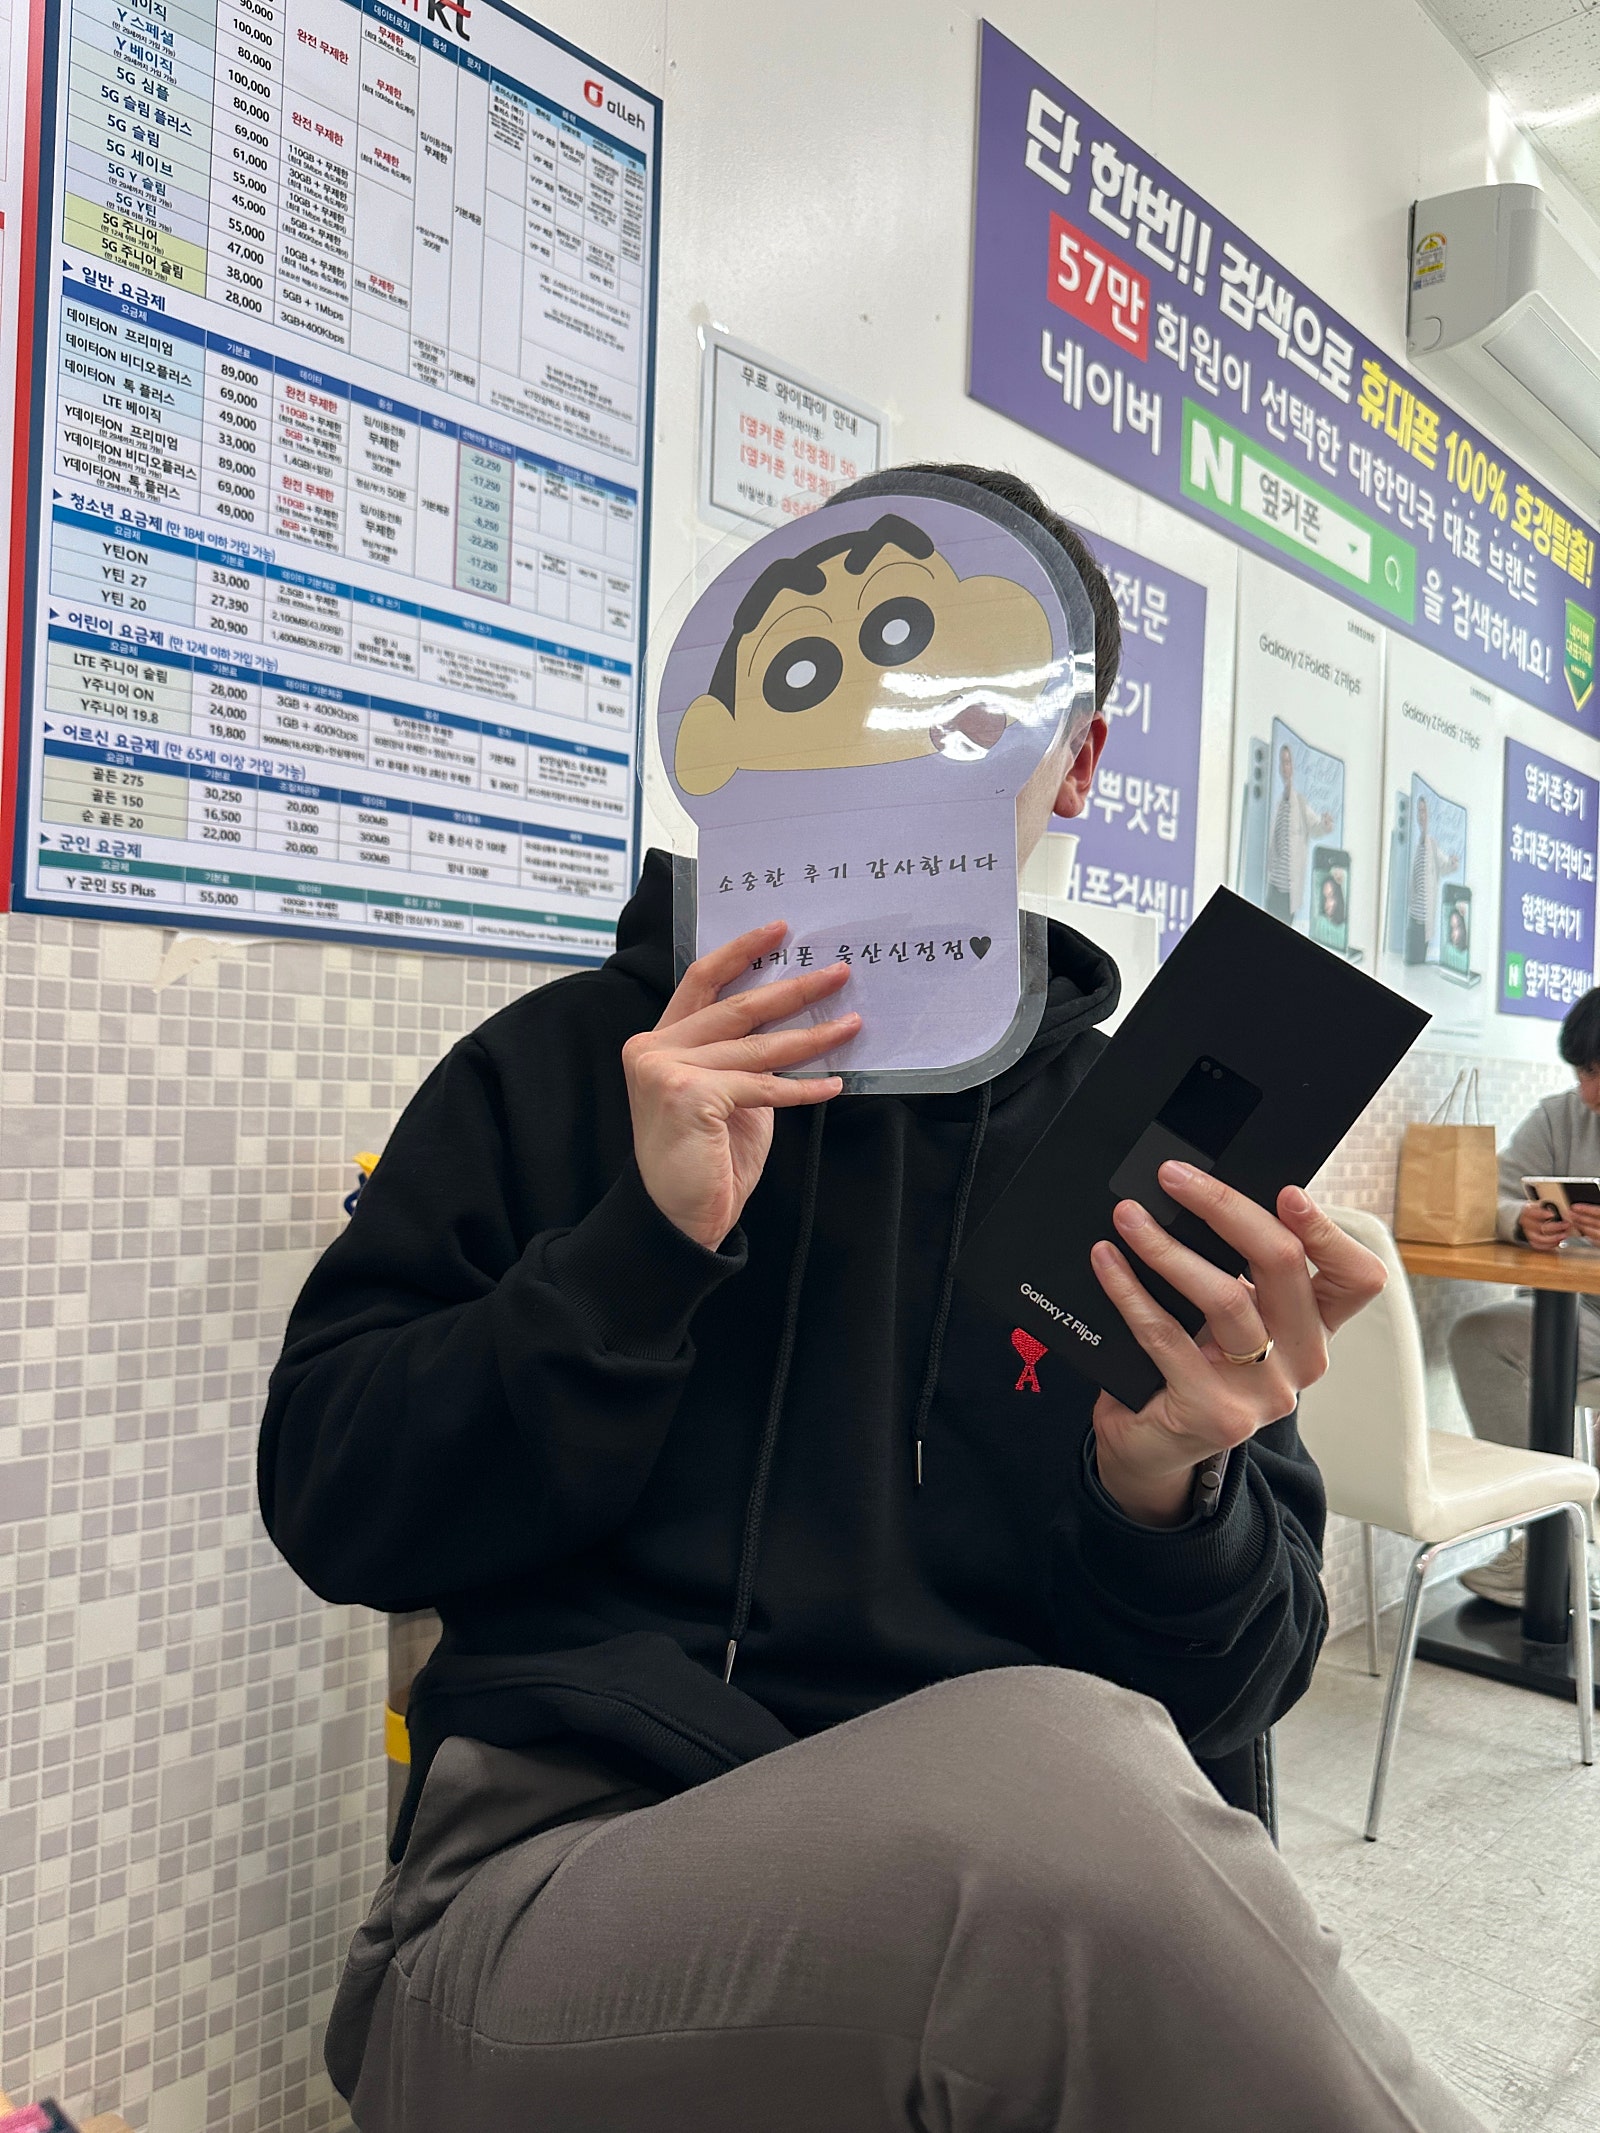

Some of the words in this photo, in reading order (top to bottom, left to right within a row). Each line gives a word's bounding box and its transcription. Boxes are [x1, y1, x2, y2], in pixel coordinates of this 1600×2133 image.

[116, 7, 128, 23] Y
[130, 15, 174, 47] 스페셜
[233, 18, 273, 46] 100,000
[115, 35, 127, 50] Y
[130, 42, 174, 75] 베이직
[237, 46, 272, 71] 80,000
[296, 28, 317, 49] 완전
[320, 41, 349, 65] 무제한
[116, 66, 136, 85] 5G
[141, 77, 170, 102] 심플
[228, 69, 271, 98] 100,000
[101, 84, 119, 103] 5G
[123, 95, 150, 118] 슬림
[154, 107, 192, 137] 플러스
[233, 97, 270, 122] 80,000
[107, 113, 127, 132] 5G
[132, 125, 160, 148] 슬림
[234, 124, 269, 147] 69,000
[106, 138, 126, 157] 5G
[131, 149, 174, 178] 세이브
[233, 147, 268, 171] 61,000
[107, 162, 125, 178] 5G
[128, 171, 138, 183] Y
[141, 177, 166, 197] 슬림
[233, 171, 267, 194] 55,000
[115, 192, 133, 208] 5G
[136, 200, 157, 219] Y틴
[231, 194, 266, 216] 45,000
[103, 212, 119, 228] 5G
[121, 219, 158, 245] 주니어
[228, 217, 265, 242] 55,000
[101, 237, 118, 253] 5G
[121, 243, 157, 270] 주니어
[160, 260, 183, 280] 슬림
[227, 241, 264, 265] 47,000
[82, 265, 114, 293] 일반
[119, 282, 166, 312] 요금제
[226, 265, 263, 289] 38,000
[225, 289, 262, 313] 28,000
[282, 289, 303, 305] 5GB
[305, 297, 312, 307] +
[315, 301, 344, 322] 1Mbps
[66, 307, 118, 336] 데이터ON
[124, 328, 174, 357] 프리미엄
[1025, 88, 1082, 195] 단
[1088, 142, 1212, 297] 한번!!
[1219, 241, 1356, 405] 검색으로
[1357, 358, 1441, 472] 휴대폰
[1444, 430, 1509, 522] 100%
[1510, 482, 1595, 590] 호갱탈출!
[65, 333, 117, 361] 데이터ON
[120, 351, 192, 387] 비디오플러스
[221, 364, 259, 386] 89,000
[64, 357, 116, 386] 데이터ON
[123, 378, 136, 393] 톡
[139, 383, 176, 406] 플러스
[102, 393, 122, 409] LTE
[126, 400, 162, 424] 베이직
[220, 387, 258, 408] 69,000
[741, 364, 769, 393] 무료
[775, 381, 827, 422] 와이파이
[832, 409, 858, 437] 안내
[65, 404, 123, 433] Y데이터ON
[130, 424, 178, 451] 프리미엄
[219, 410, 257, 431] 49,000
[1057, 232, 1146, 344] 57만
[1154, 301, 1250, 415] 회원이
[1260, 379, 1342, 478] 선택한
[1349, 440, 1438, 544] 대한민국
[1443, 508, 1482, 569] 대표
[1486, 538, 1540, 608] 브랜드
[63, 430, 122, 458] Y데이터ON
[126, 449, 198, 480] 비디오플러스
[218, 432, 256, 454] 33,000
[62, 456, 121, 483] Y데이터ON
[128, 474, 141, 489] 톡
[144, 480, 181, 500] 플러스
[218, 457, 256, 478] 89,000
[217, 480, 256, 500] 69,000
[217, 503, 255, 522] 49,000
[1041, 328, 1163, 456] 네이버
[1190, 418, 1235, 507] N
[1259, 471, 1322, 546] 옆커폰
[1422, 566, 1446, 626] 을
[1451, 584, 1552, 685] 검색하세요!
[70, 492, 114, 519] 청소년
[119, 508, 163, 531] 요금제
[166, 519, 181, 537] (만
[183, 525, 205, 542] 18세
[207, 532, 228, 548] 이하
[230, 538, 251, 556] 가입
[252, 545, 276, 563] 가능)
[102, 542, 149, 565] Y틴ON
[101, 565, 126, 584] Y틴
[130, 573, 148, 588] 27
[211, 570, 250, 591] 33,000
[210, 593, 249, 613] 27,390
[1101, 562, 1170, 646] 전문
[68, 611, 113, 634] 어린이
[119, 623, 164, 646] 요금제
[1259, 632, 1297, 670] Galaxy
[1298, 652, 1305, 669] Z
[74, 652, 97, 668] LTE
[100, 658, 139, 678] 주니어
[143, 667, 168, 684] 슬림
[210, 682, 248, 701] 28,000
[63, 724, 109, 747] 어르신
[115, 733, 159, 755] 요금제
[92, 767, 118, 783] 골든
[122, 773, 144, 787] 275
[1525, 762, 1586, 822] 옆커폰후기
[205, 786, 242, 804] 30,250
[59, 833, 90, 854] 군인
[96, 841, 142, 859] 요금제
[1509, 822, 1595, 882] 휴대폰가격비교
[67, 876, 77, 889] Y
[80, 877, 107, 893] 군인
[111, 880, 127, 895] 55
[131, 882, 156, 898] Plus
[718, 866, 786, 894] 소중한
[803, 862, 848, 884] 후기
[866, 852, 998, 880] 감사합니다
[199, 890, 239, 907] 55,000
[1521, 891, 1583, 943] 현찰박치기
[1019, 1282, 1065, 1321] Galaxy
[1061, 1312, 1075, 1327] Z
[1070, 1319, 1102, 1346] Flip5
